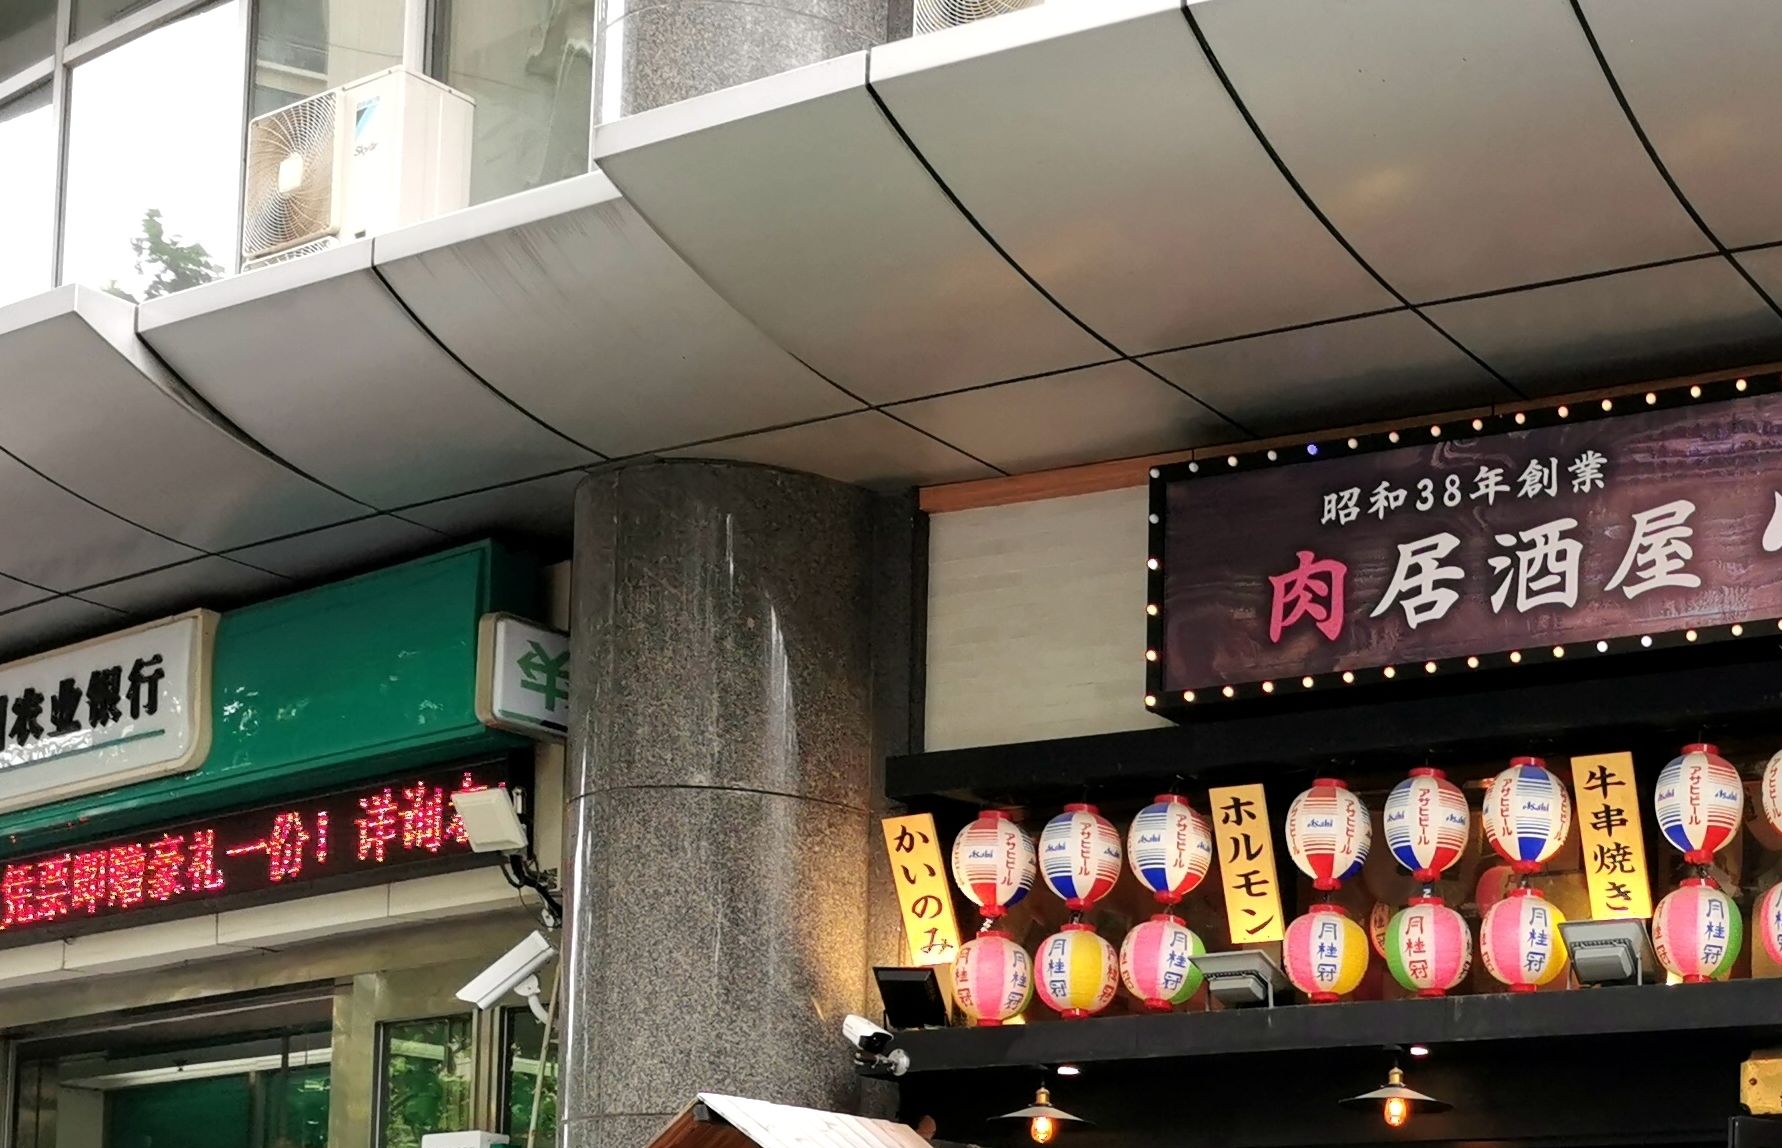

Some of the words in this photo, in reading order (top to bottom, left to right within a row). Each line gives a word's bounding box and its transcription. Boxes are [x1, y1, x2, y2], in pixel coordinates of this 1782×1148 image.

[1320, 450, 1609, 528] 昭和38年創業
[1268, 497, 1706, 645] 肉居酒屋
[0, 653, 165, 752] 农业银行
[1418, 788, 1430, 846] アサヒビール
[1501, 779, 1513, 837] アサヒビール
[1523, 801, 1549, 813] Asahi
[1689, 766, 1701, 825] アサヒビール
[1715, 789, 1738, 801] Asahi
[1769, 757, 1782, 818] アサヒビール
[1080, 822, 1091, 875] アサヒビール
[1138, 833, 1160, 844] Asahi
[1173, 814, 1187, 868] アサヒビール
[1307, 819, 1333, 829] Asahi
[1341, 799, 1355, 855] アサヒビール
[1584, 765, 1635, 911] 牛串焼き
[969, 850, 993, 859] Asahi
[1001, 833, 1015, 886] アサヒビール
[1220, 796, 1275, 935] ホルモン
[893, 824, 956, 954] かいのみ
[1163, 931, 1188, 990] 月桂冠
[1317, 922, 1337, 982] 月桂冠
[1406, 915, 1428, 979] 月桂冠
[1523, 907, 1548, 973] 月桂冠
[1701, 898, 1725, 965] 月桂冠
[1004, 951, 1027, 1010] 月桂冠
[1049, 938, 1067, 998] 月桂冠
